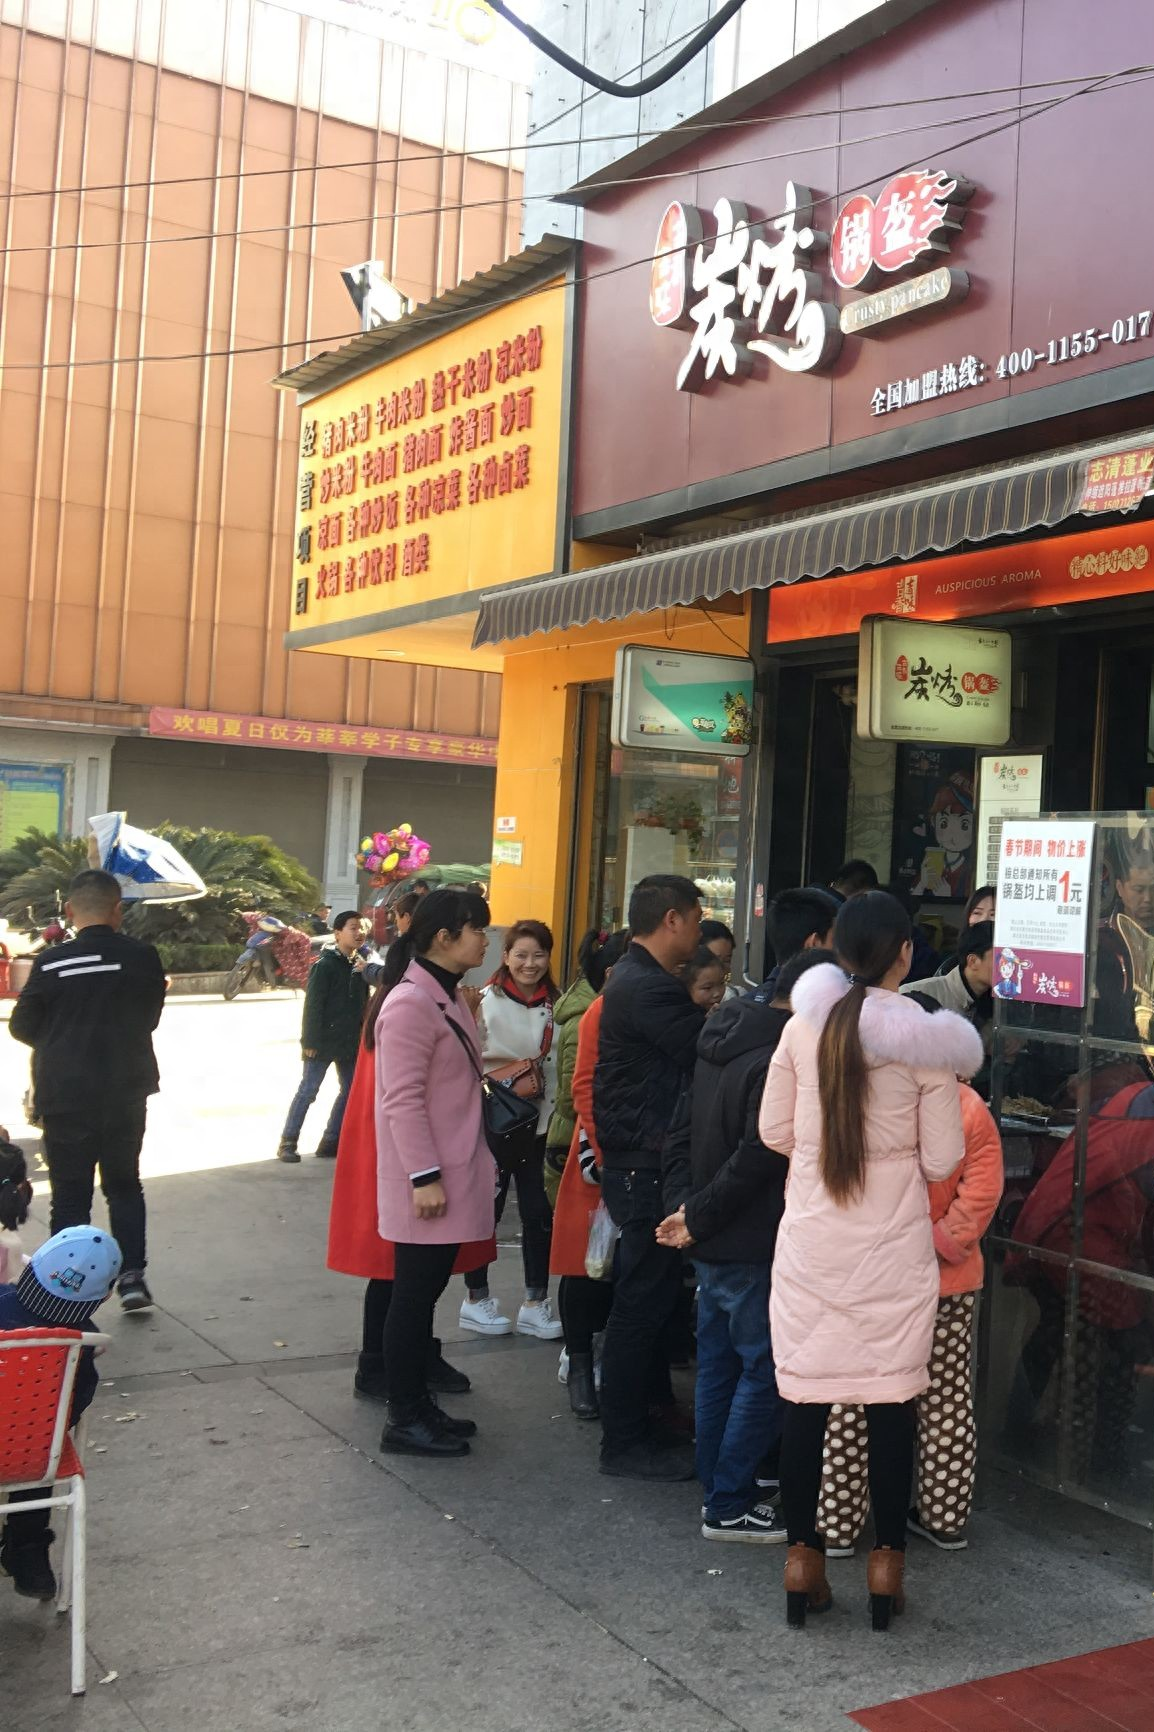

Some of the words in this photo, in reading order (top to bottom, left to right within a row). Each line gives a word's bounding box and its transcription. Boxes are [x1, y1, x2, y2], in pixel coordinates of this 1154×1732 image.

[996, 311, 1154, 380] 400-1155-017
[935, 575, 997, 594] AUSPICIOUS
[1001, 569, 1042, 584] AROMA
[1005, 838, 1043, 858] 春节期间
[1047, 839, 1087, 858] 物价上涨
